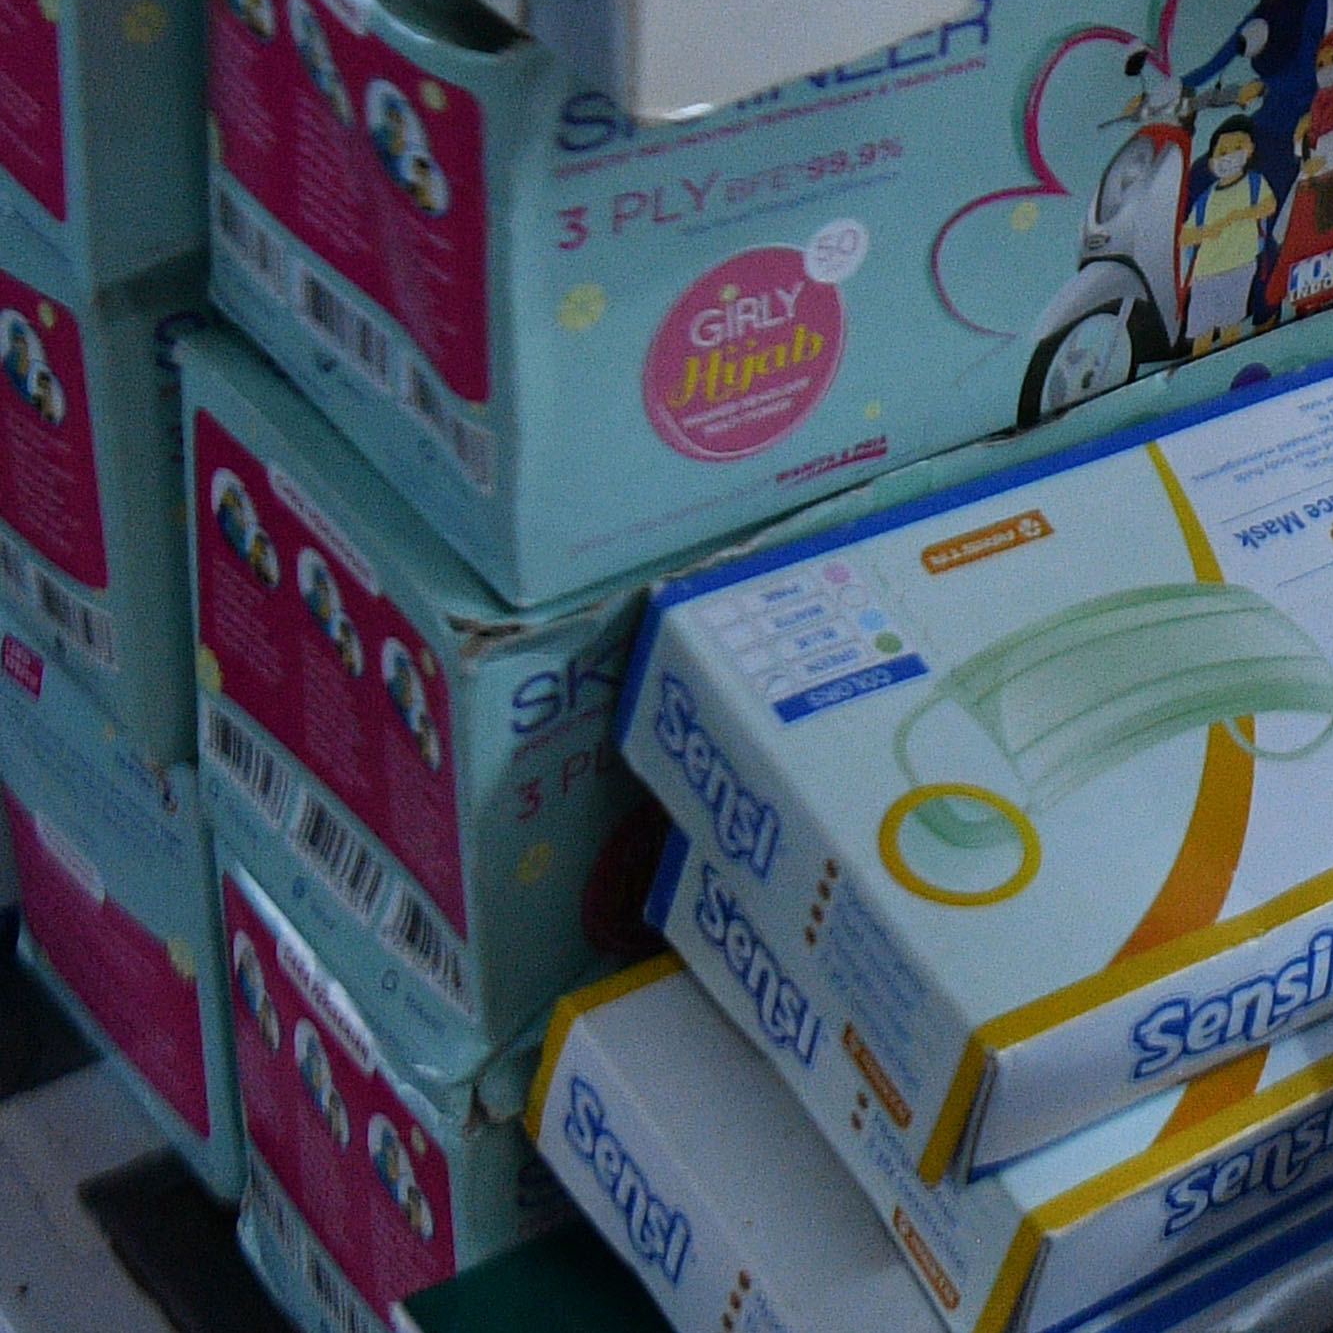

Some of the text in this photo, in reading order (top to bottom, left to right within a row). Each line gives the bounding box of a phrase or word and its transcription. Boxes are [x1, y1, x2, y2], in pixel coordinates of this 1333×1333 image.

[557, 205, 590, 251] 3
[613, 170, 721, 236] PLY
[667, 323, 824, 408] Hijab
[1234, 505, 1306, 549] Mask
[515, 777, 543, 820] 3
